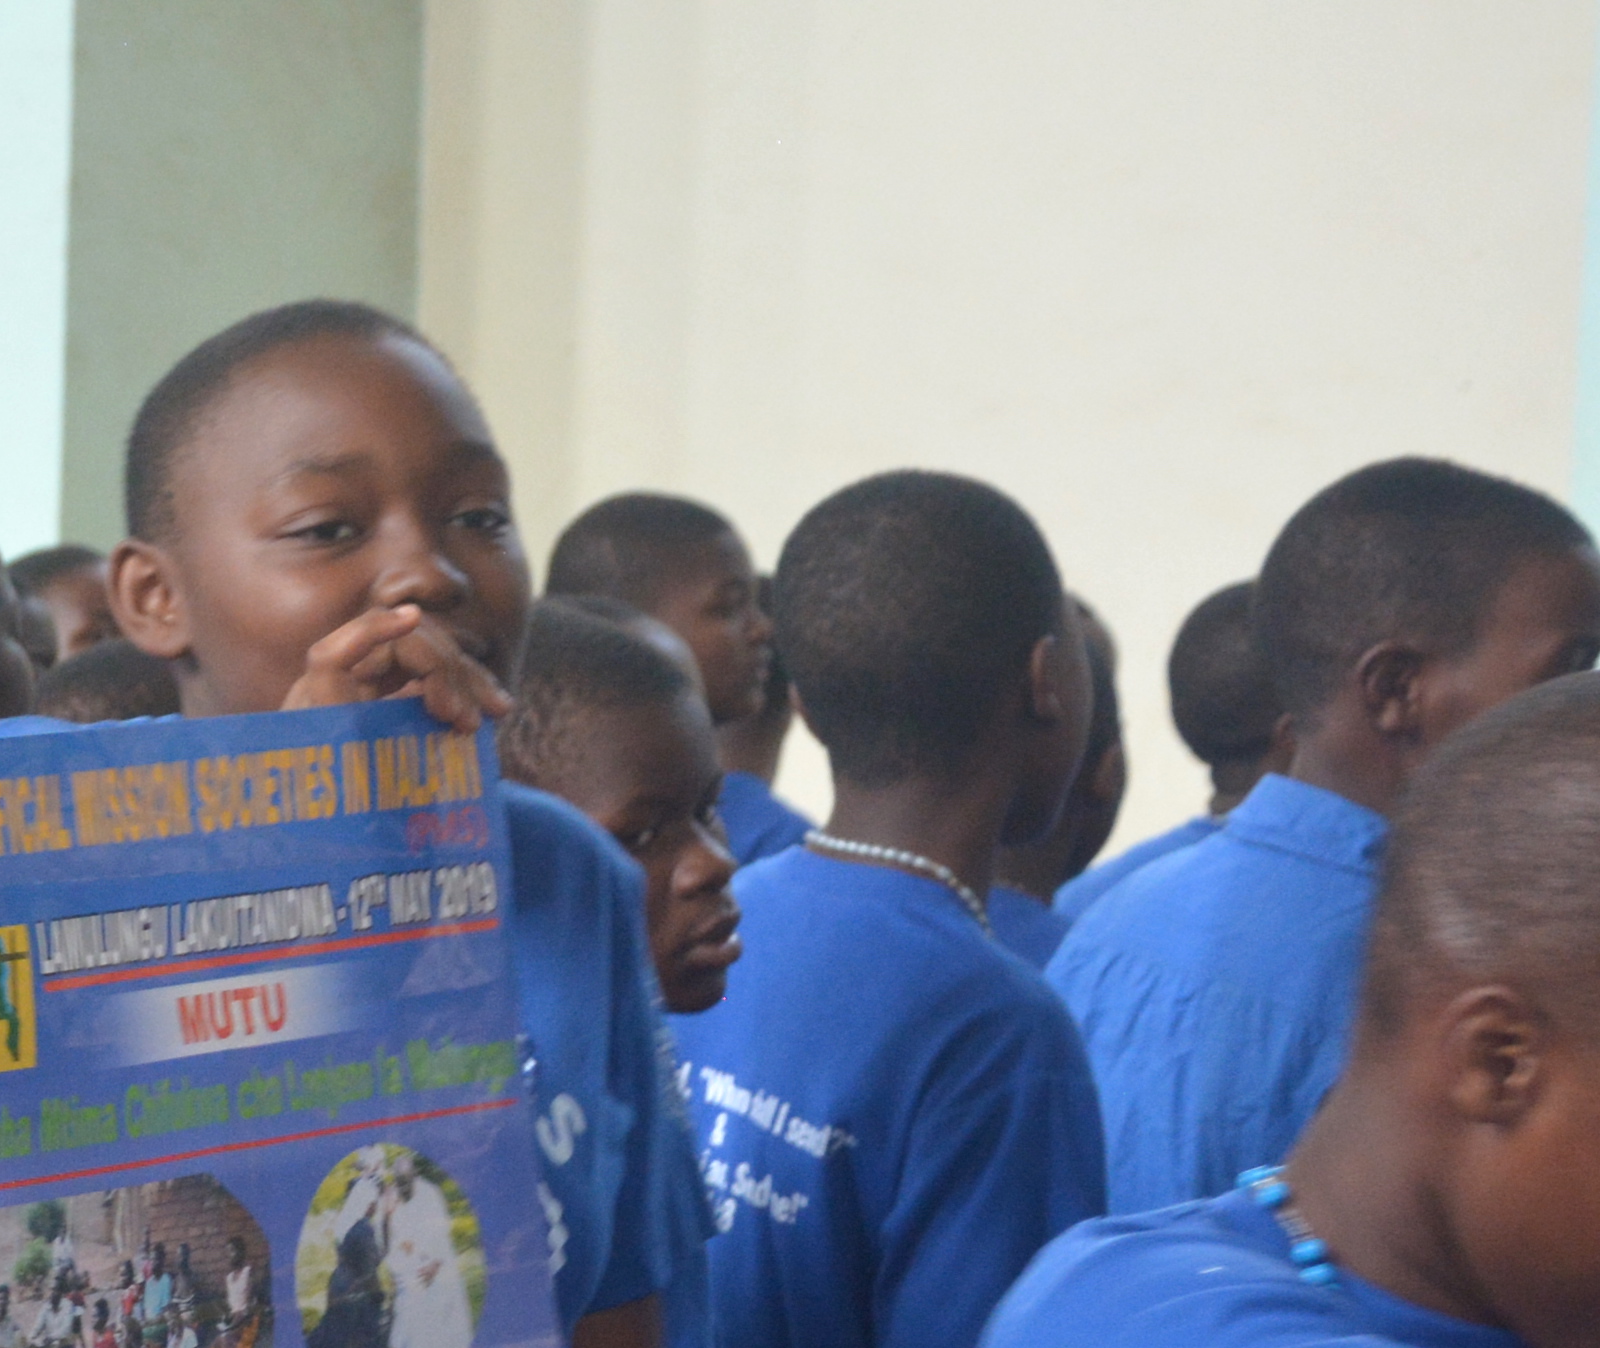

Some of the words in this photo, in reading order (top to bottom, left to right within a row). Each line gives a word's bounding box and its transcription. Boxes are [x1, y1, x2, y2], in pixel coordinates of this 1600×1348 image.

[71, 762, 193, 845] MISSION
[195, 746, 337, 831] SOCIETIES
[342, 742, 371, 813] IN
[375, 732, 483, 809] MALAWI
[389, 870, 432, 925] MAY
[435, 862, 498, 918] 2019
[174, 984, 287, 1044] MUTU
